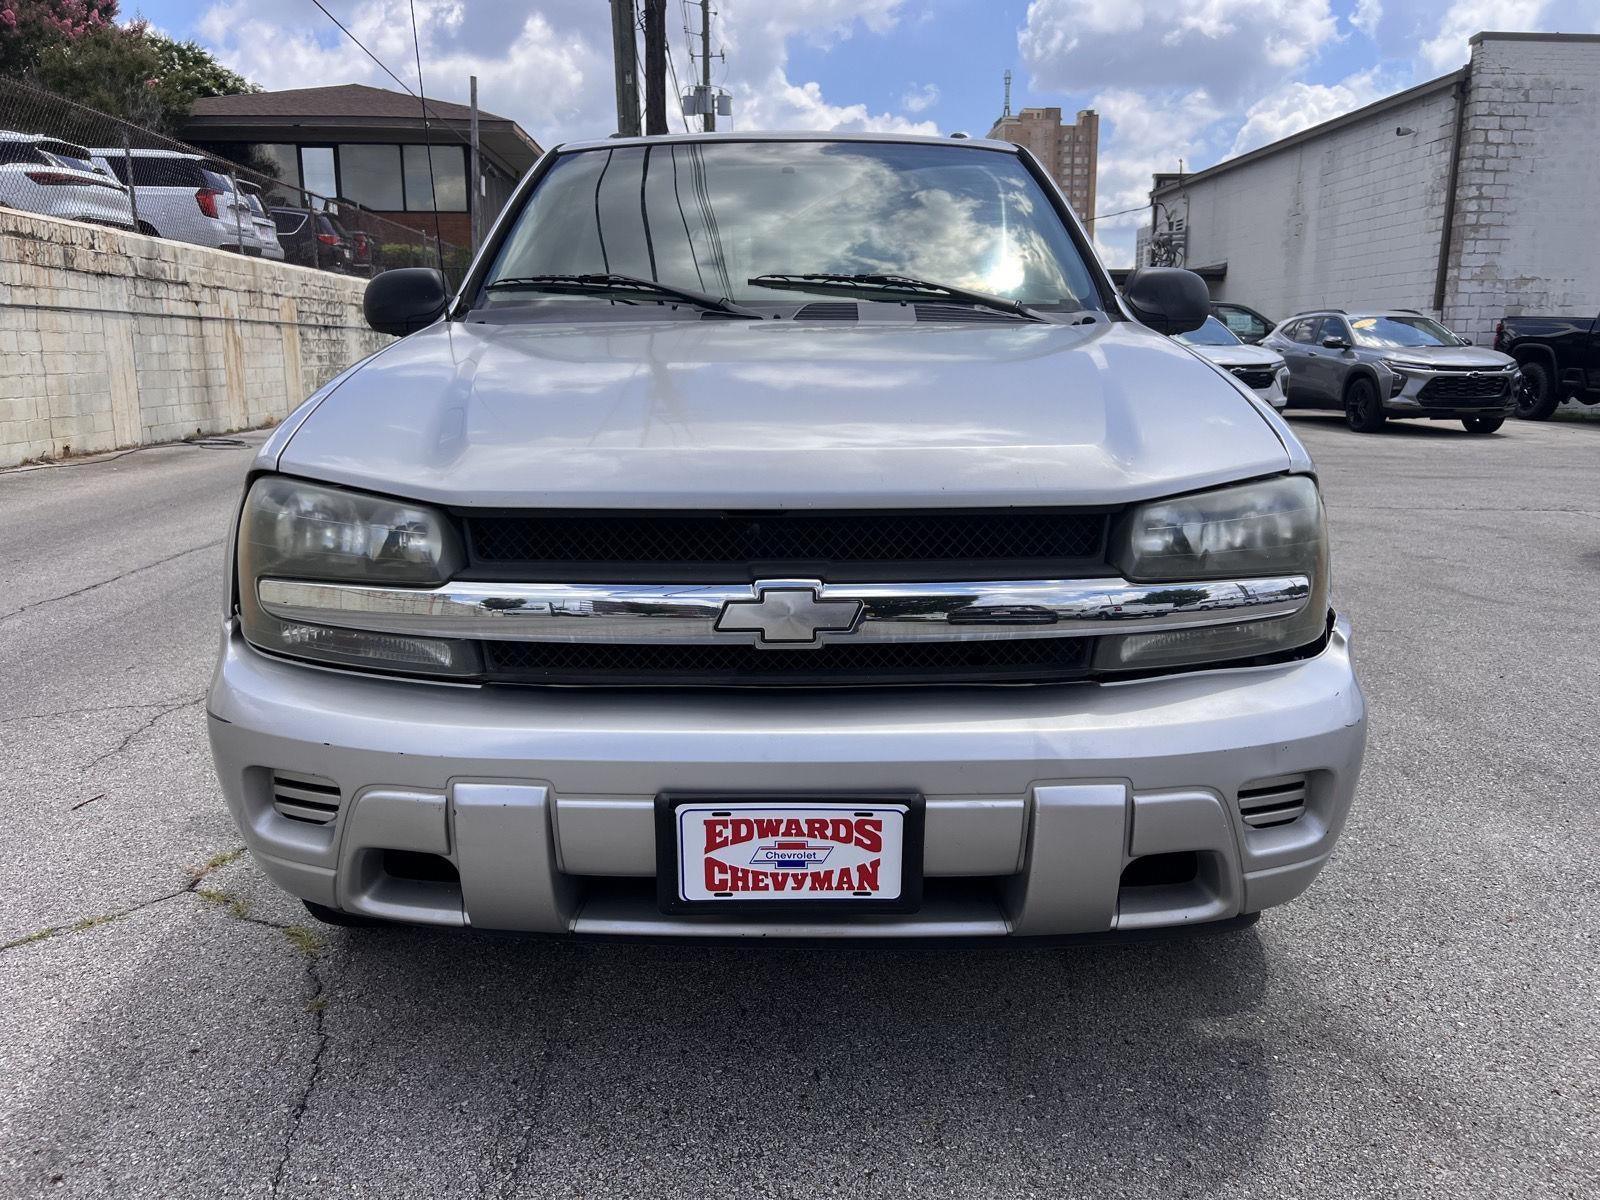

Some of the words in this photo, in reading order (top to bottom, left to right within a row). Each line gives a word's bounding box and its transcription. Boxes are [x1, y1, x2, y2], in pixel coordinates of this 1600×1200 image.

[704, 818, 883, 855] EDWARDS
[765, 851, 817, 860] Chevrolet
[704, 857, 881, 892] CHEVYMAN
